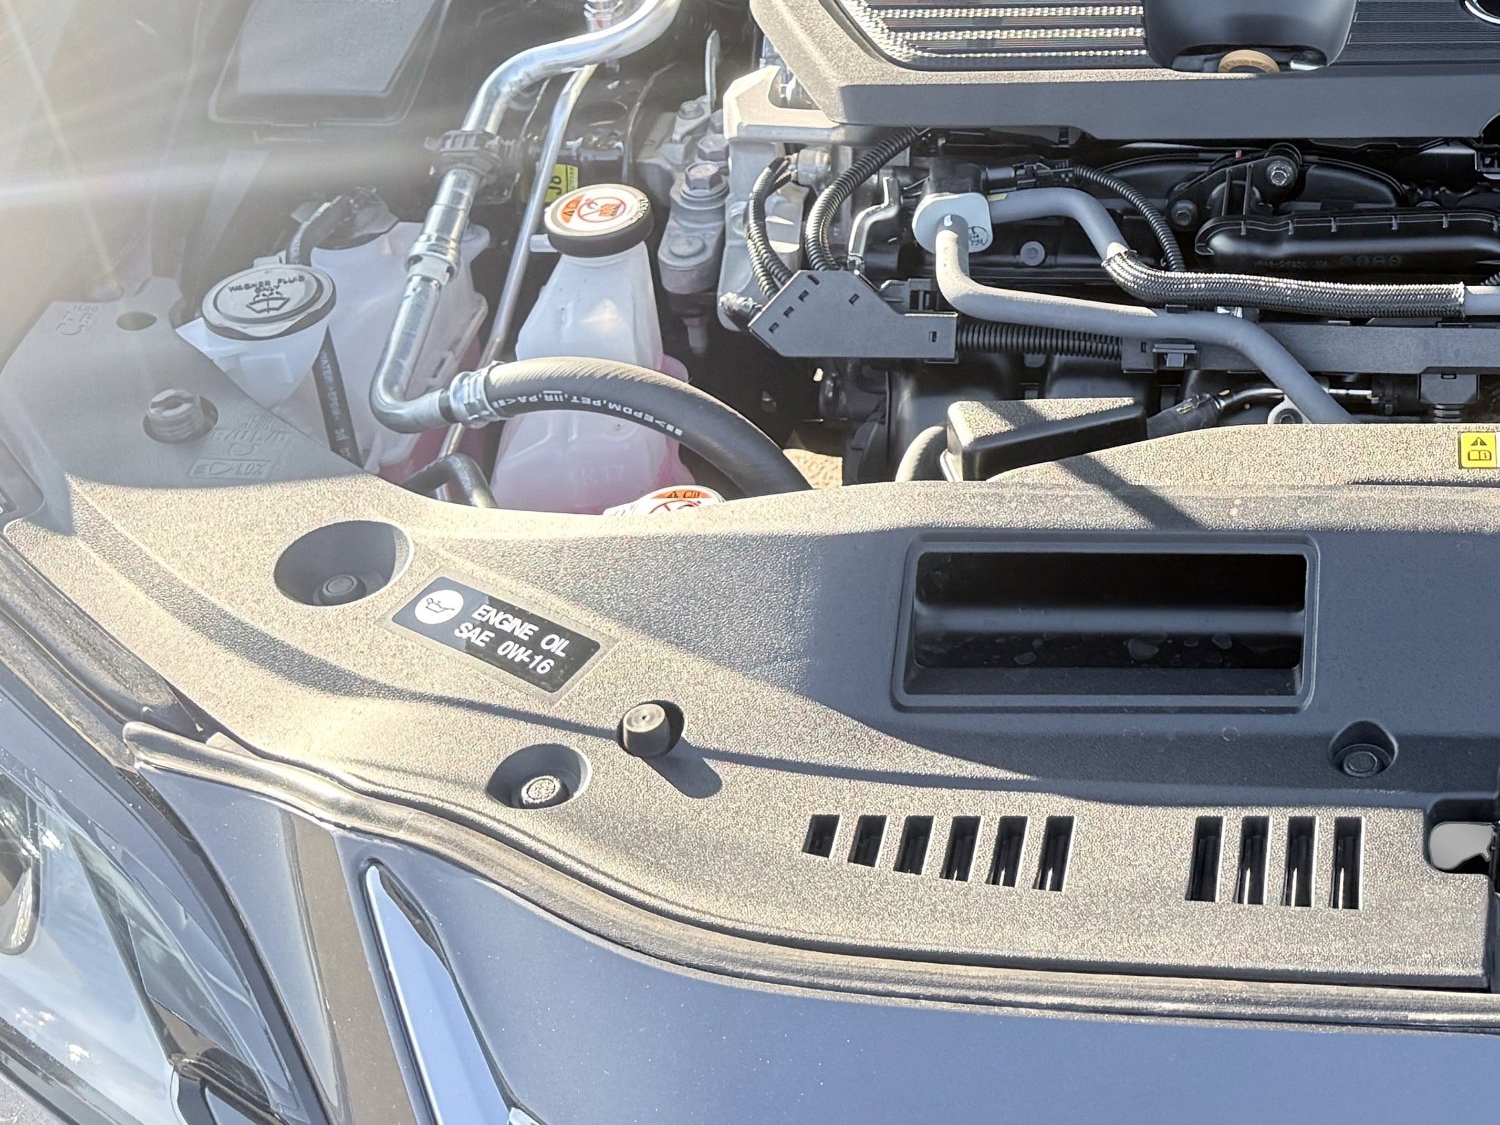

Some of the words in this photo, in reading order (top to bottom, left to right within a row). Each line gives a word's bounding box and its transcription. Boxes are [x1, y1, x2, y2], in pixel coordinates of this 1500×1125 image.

[277, 275, 305, 286] FLUID
[454, 622, 495, 647] SAE
[497, 640, 555, 675] 0W-16
[471, 604, 539, 641] ENGINE
[540, 633, 570, 658] OIL
